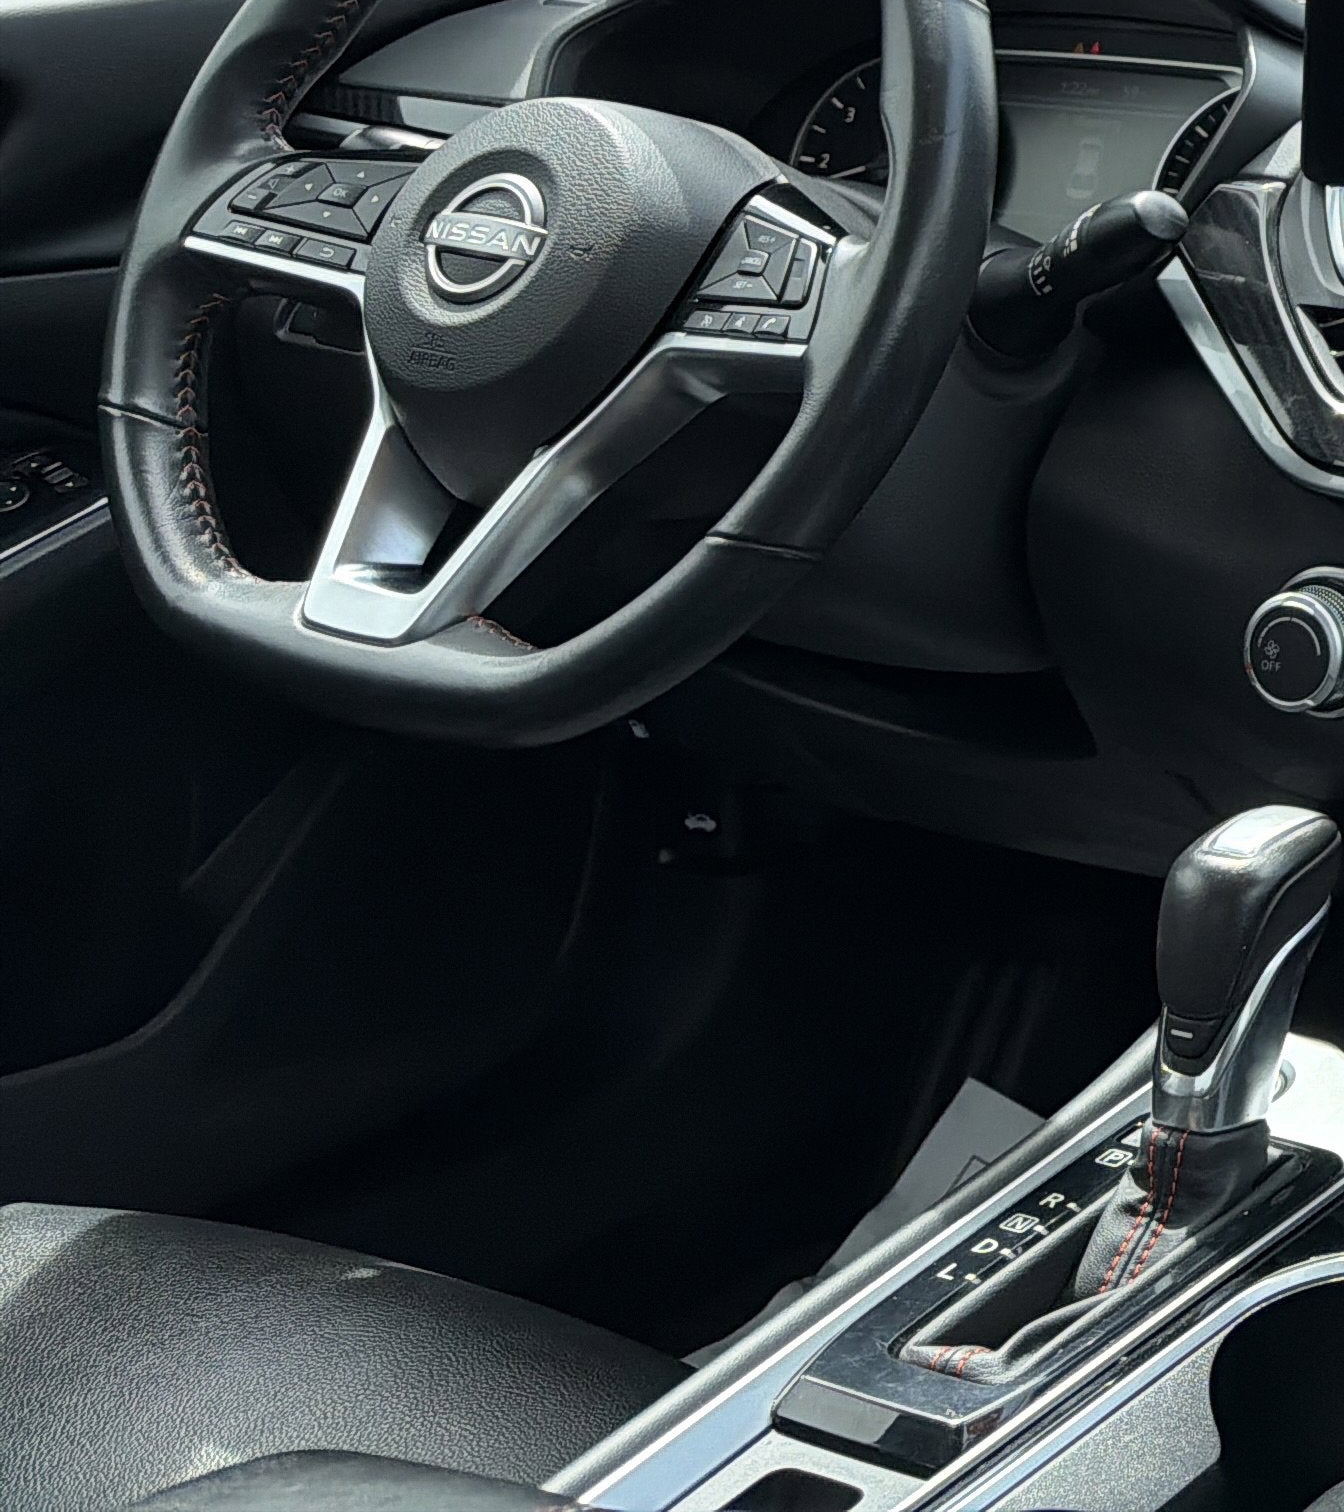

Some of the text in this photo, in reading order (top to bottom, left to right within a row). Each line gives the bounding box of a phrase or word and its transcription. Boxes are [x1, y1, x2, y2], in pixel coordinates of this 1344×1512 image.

[844, 106, 856, 123] 3
[817, 153, 830, 169] 2
[332, 187, 349, 198] OK
[425, 220, 543, 257] NISSAN
[407, 350, 456, 371] AIRBAG
[1260, 659, 1282, 672] OFF
[1039, 1192, 1066, 1209] R
[970, 1238, 999, 1254] D
[936, 1262, 958, 1281] L
